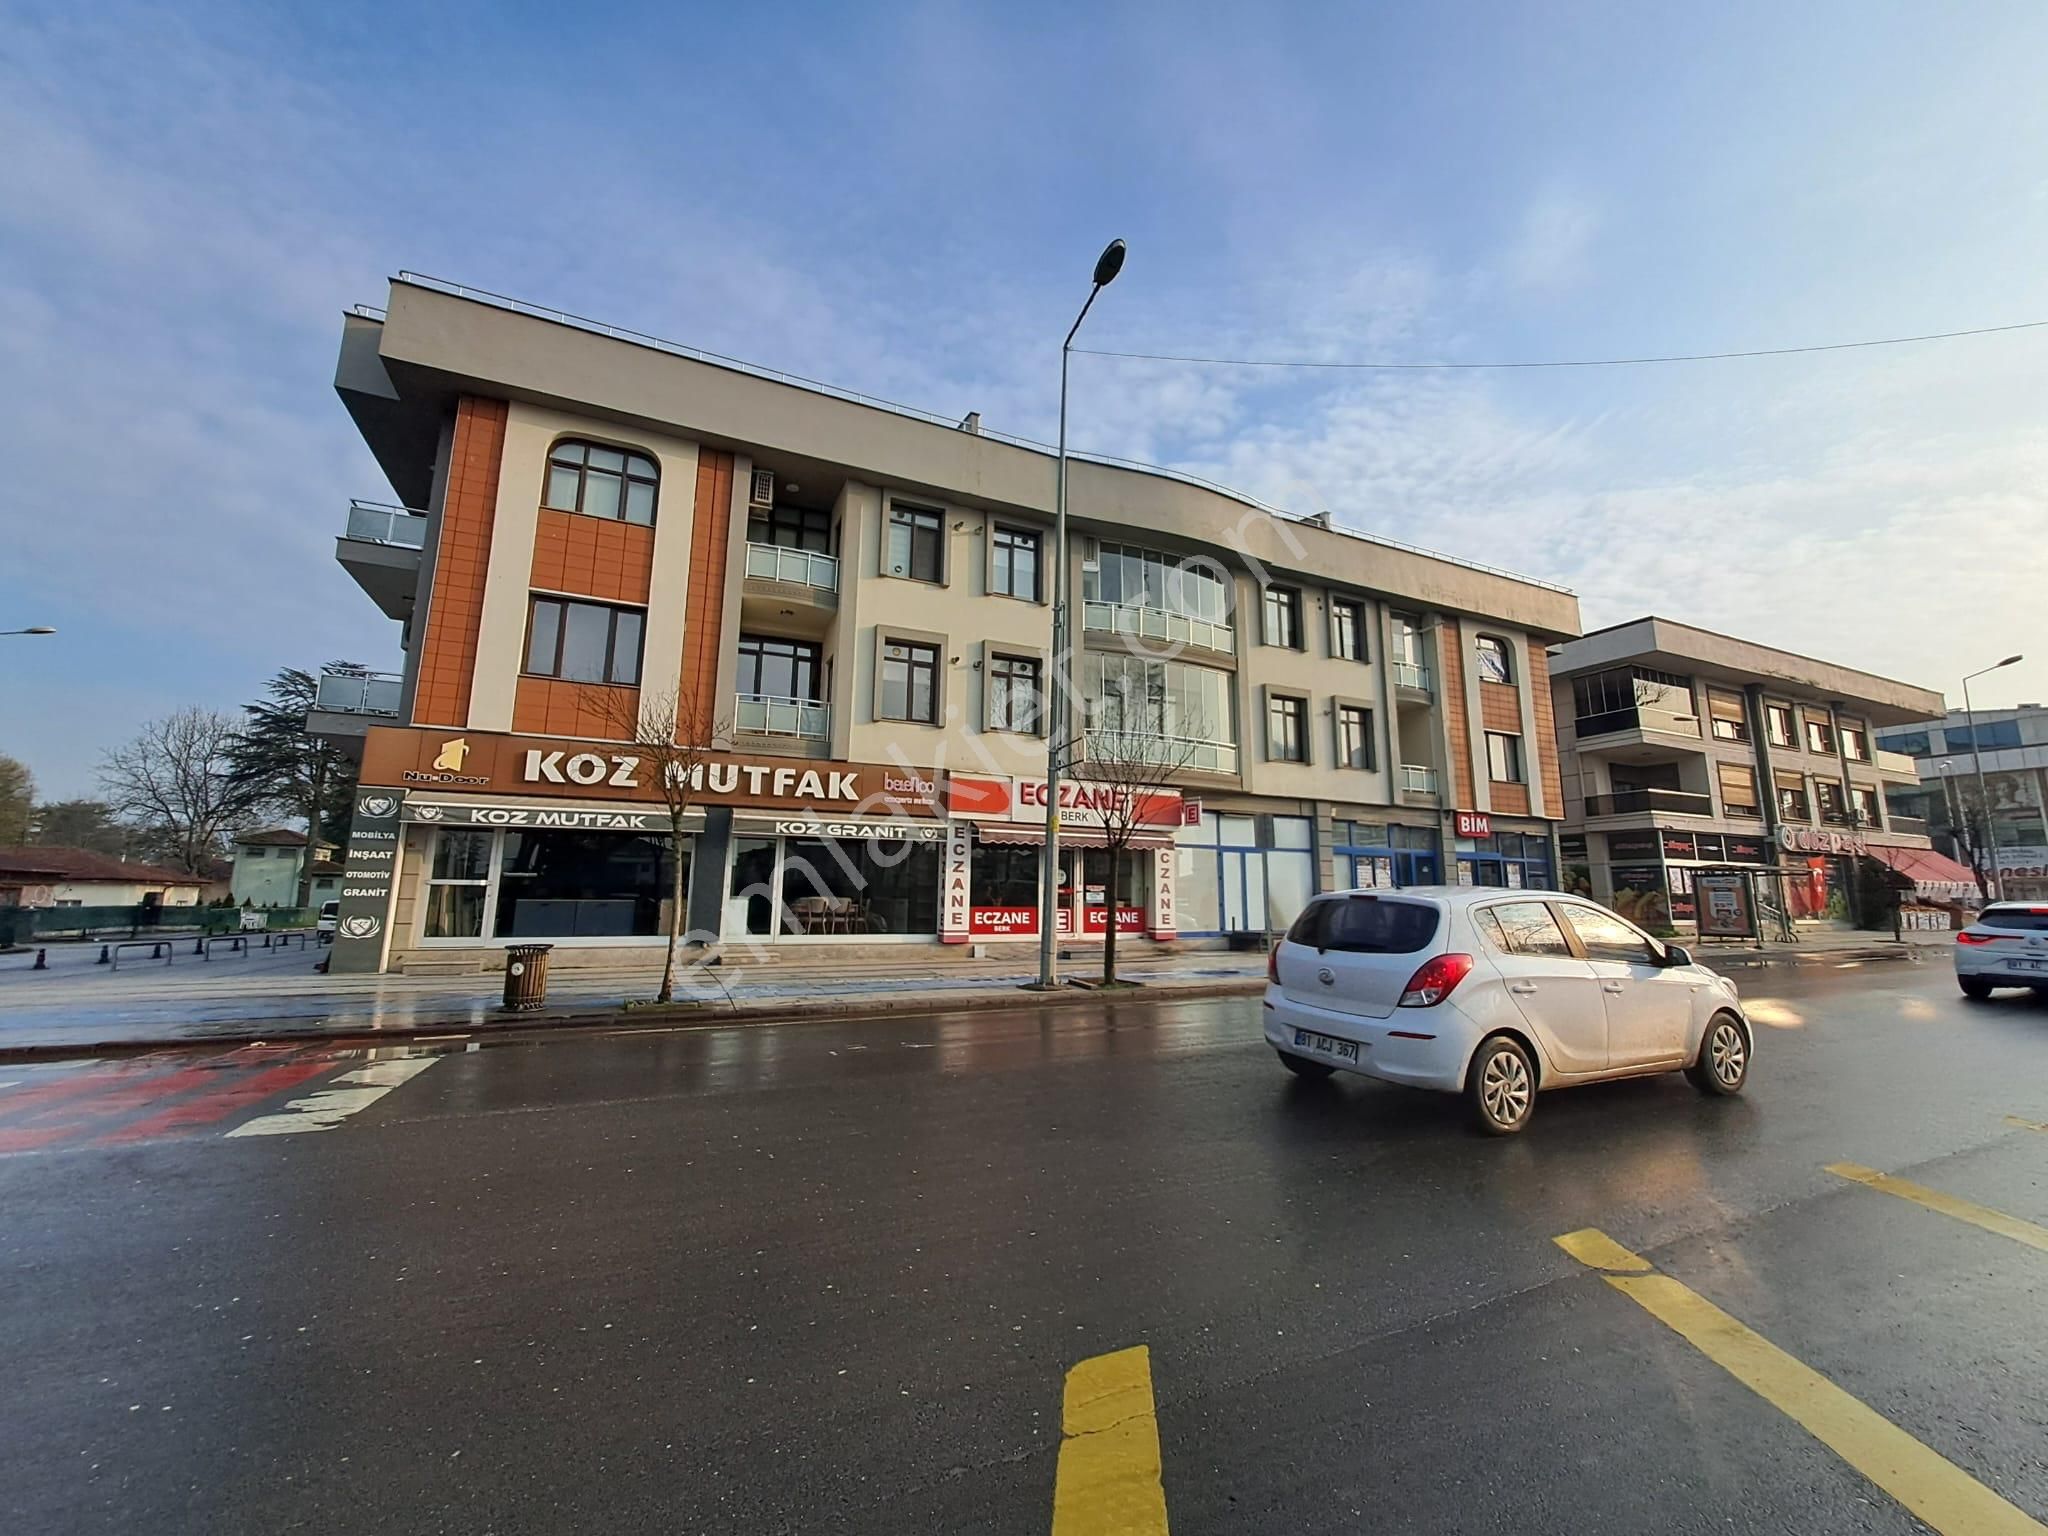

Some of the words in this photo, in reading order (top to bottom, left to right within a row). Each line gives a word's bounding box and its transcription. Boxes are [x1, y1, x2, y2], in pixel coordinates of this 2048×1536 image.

[523, 748, 640, 787] KOZ
[664, 759, 860, 801] MUTFAK
[1019, 781, 1126, 812] ECZANE
[470, 809, 529, 826] KOZ
[534, 811, 647, 829] MUTFAK
[1061, 810, 1089, 822] BERK
[1460, 813, 1489, 833] BİM
[775, 821, 823, 836] KOZ
[348, 848, 393, 861] İNŞAAT
[345, 870, 391, 879] OTOMOTİV
[951, 826, 966, 926] ECZANE
[342, 887, 389, 897] GRANİT
[974, 911, 1030, 925] ECZANE
[1089, 911, 1139, 924] ECANE
